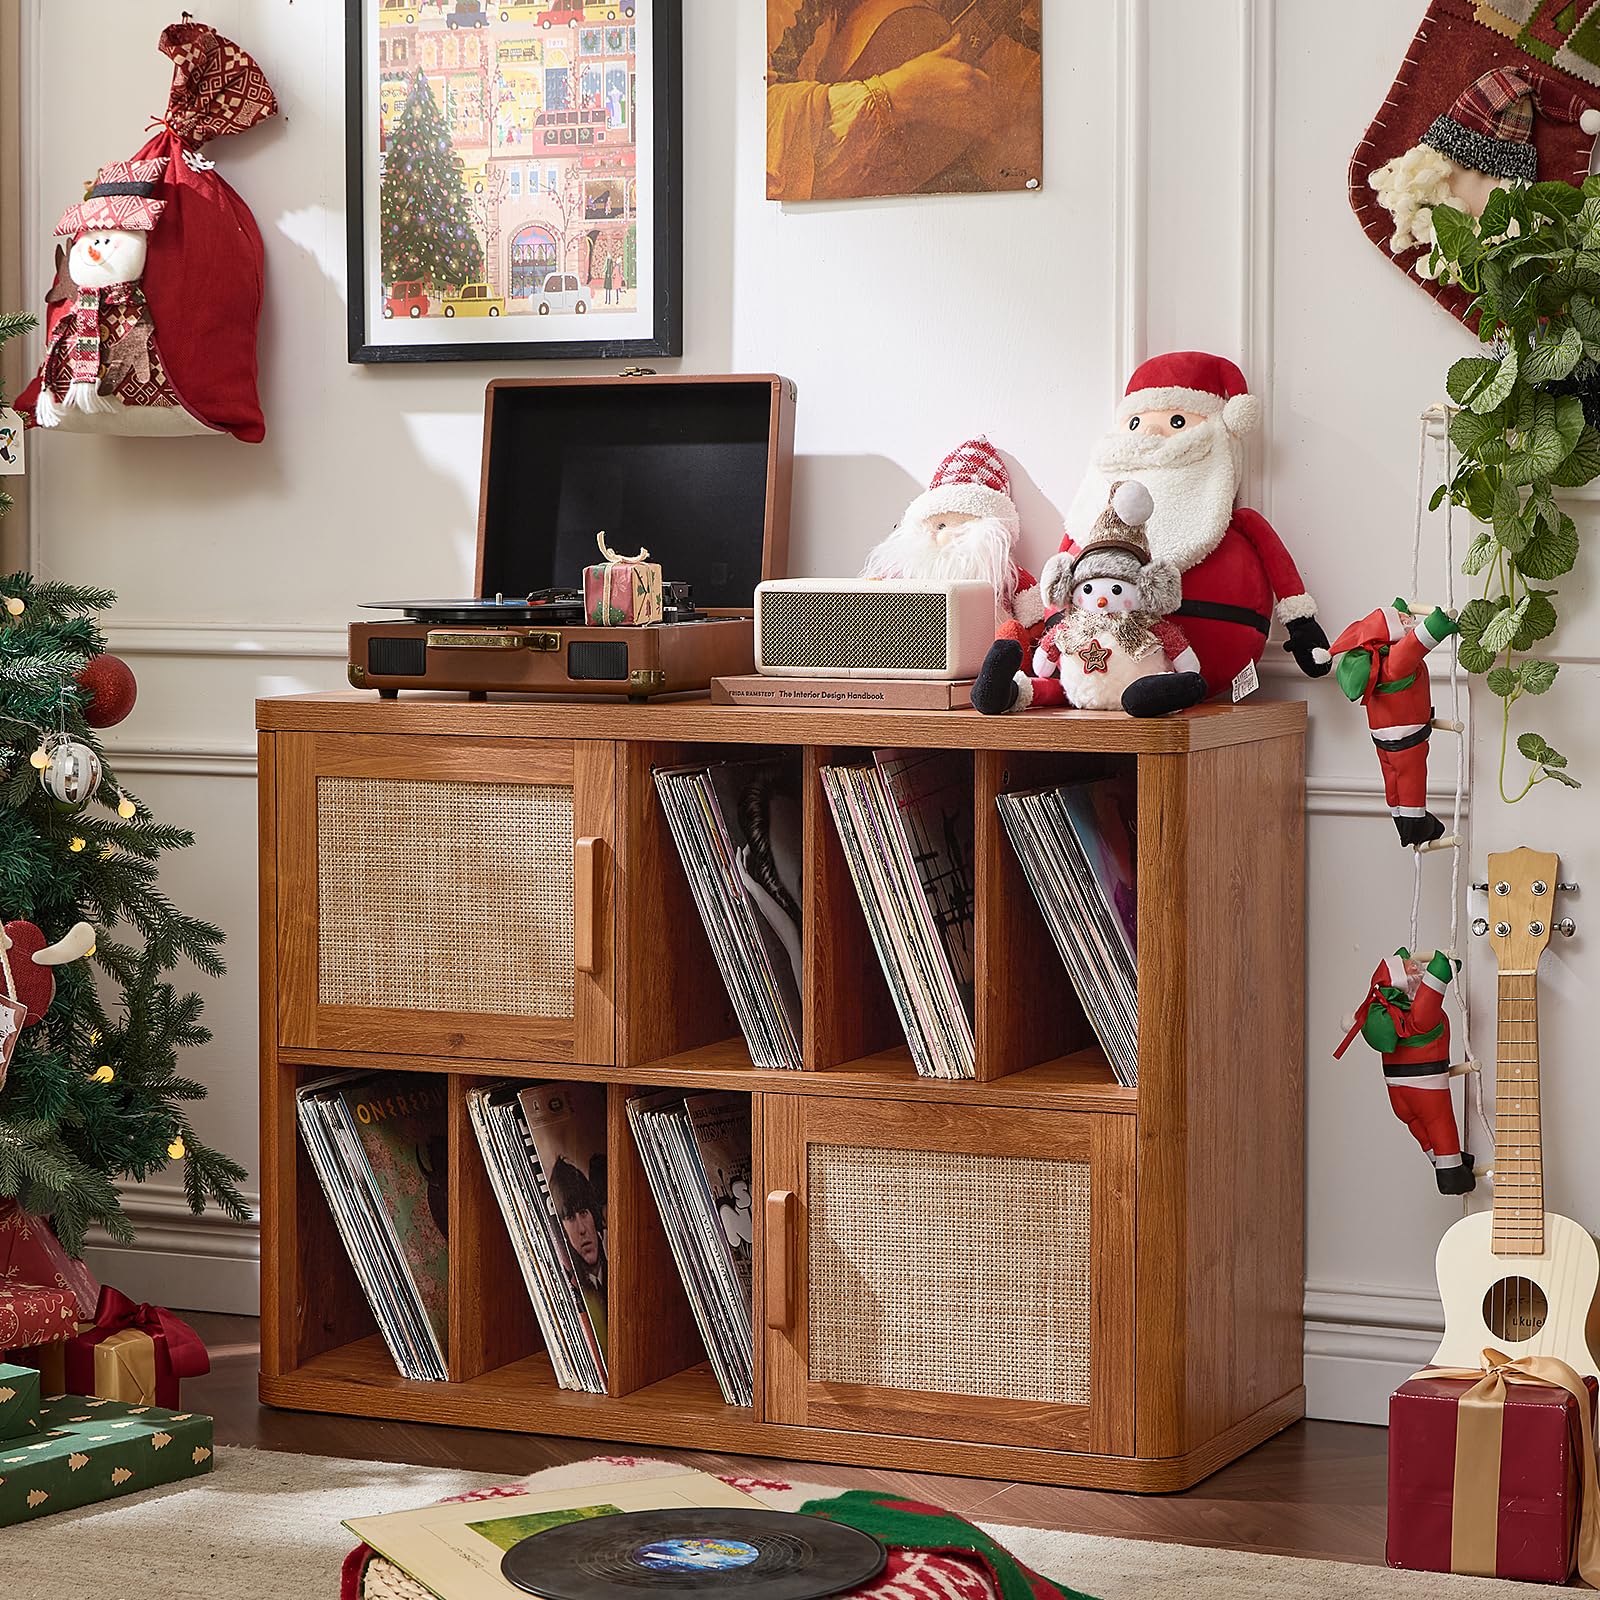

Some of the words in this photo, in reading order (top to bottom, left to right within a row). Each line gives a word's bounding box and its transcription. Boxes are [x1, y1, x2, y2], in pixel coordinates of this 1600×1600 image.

[779, 690, 792, 698] The
[793, 690, 820, 699] Interior
[821, 691, 846, 700] Design
[847, 692, 885, 700] Handbook
